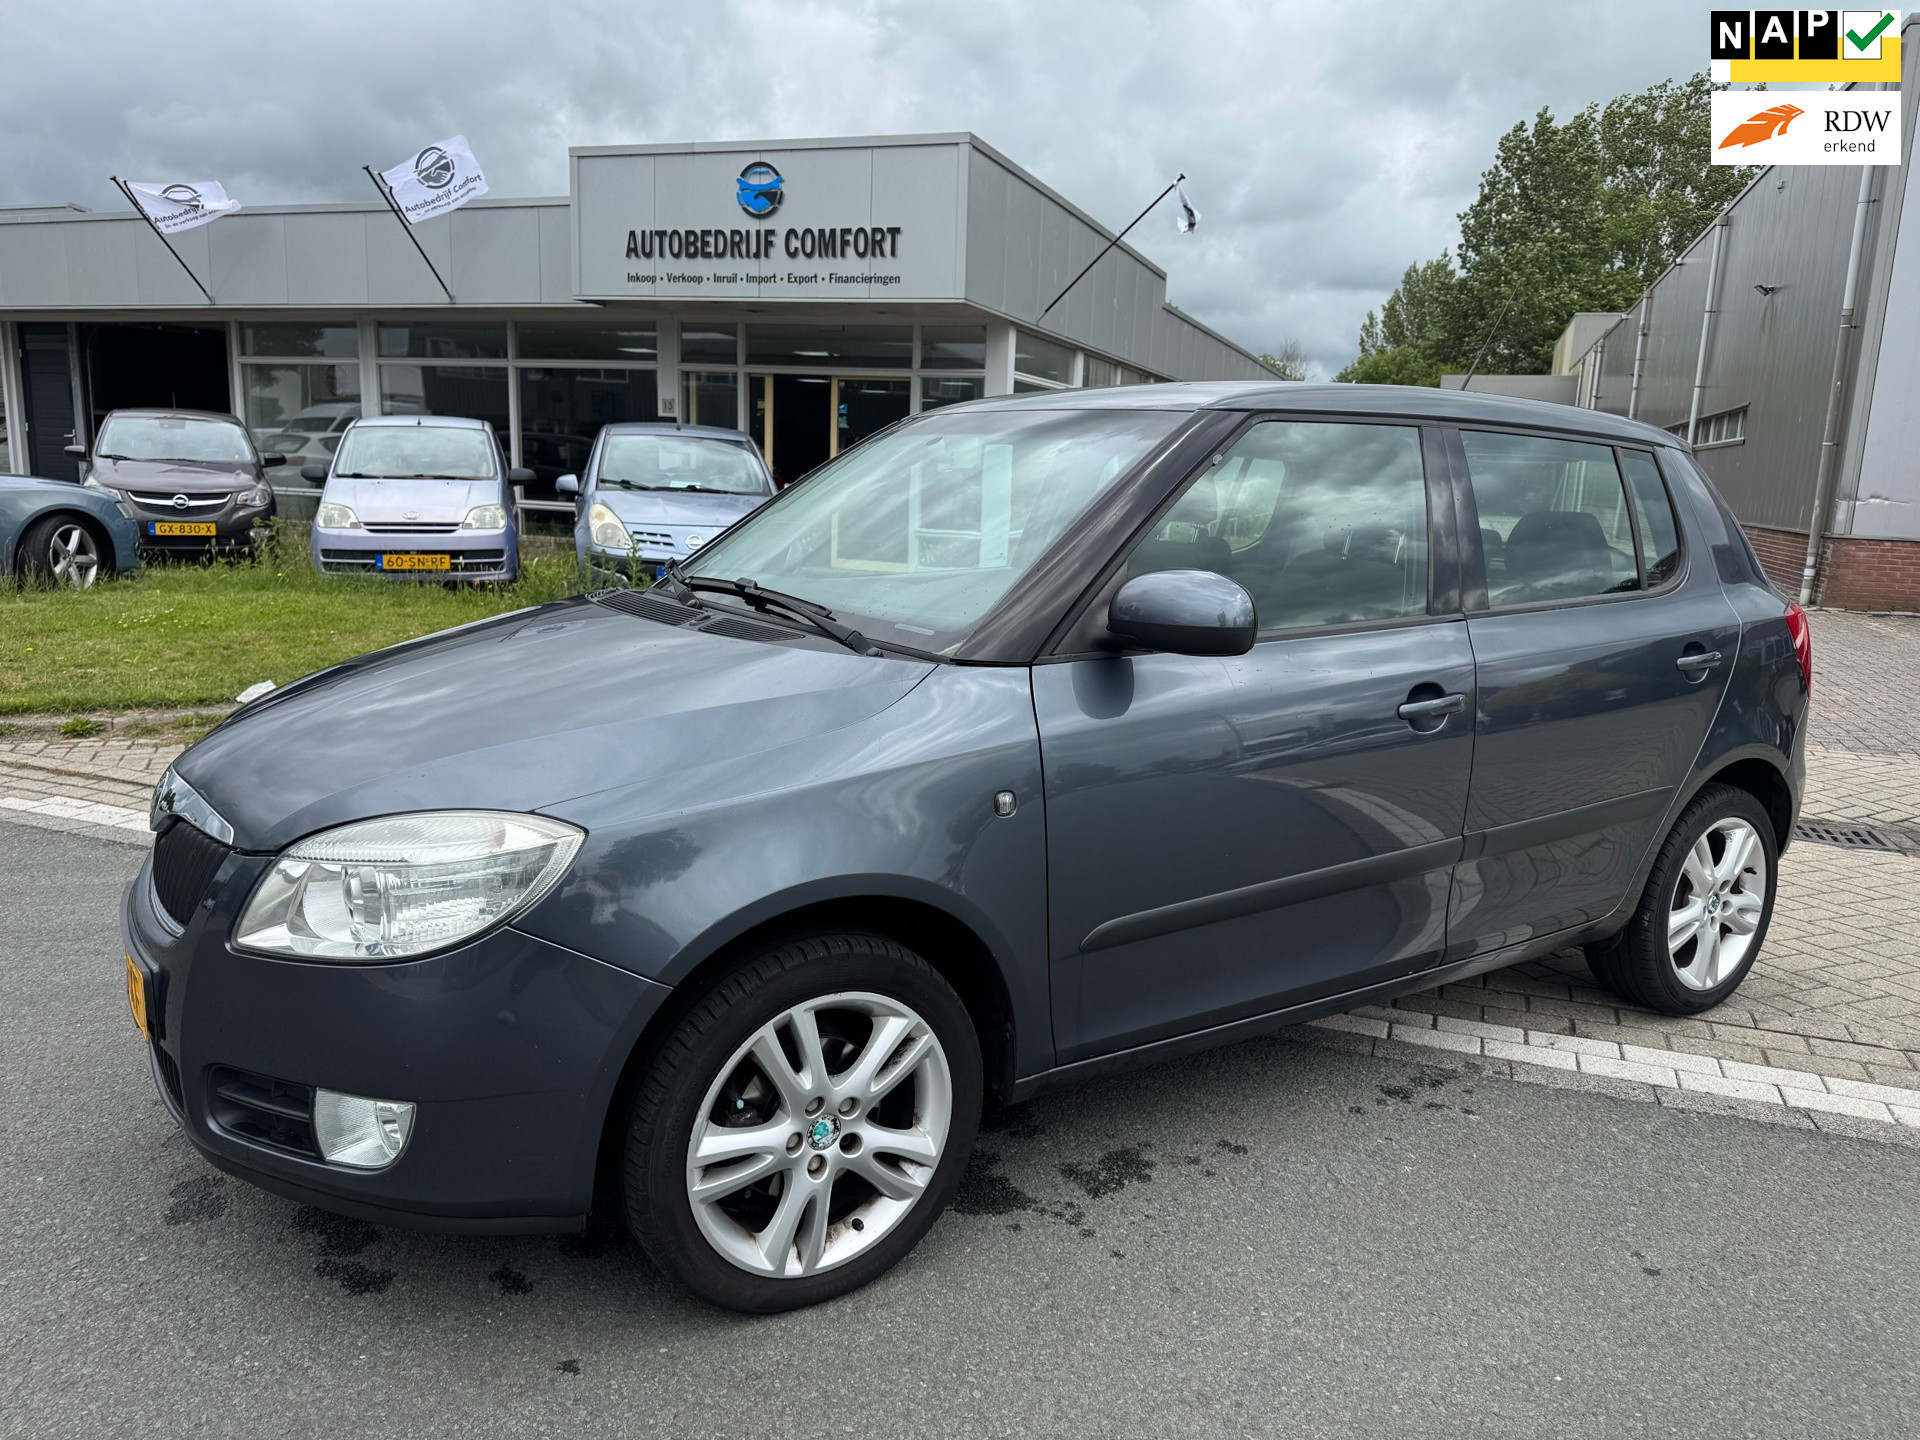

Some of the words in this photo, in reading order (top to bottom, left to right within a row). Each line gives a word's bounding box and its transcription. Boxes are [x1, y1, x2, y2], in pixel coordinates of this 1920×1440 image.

[405, 188, 452, 213] Autobedrijf
[453, 174, 483, 193] Comfort
[625, 229, 776, 259] AUTOBEDRIJF
[784, 227, 902, 259] COMFORT
[627, 272, 657, 284] Inkoop
[666, 272, 703, 285] Verkoop
[713, 272, 738, 284] Inruil
[746, 272, 777, 285] Import
[787, 272, 818, 285] Export
[829, 272, 901, 286] Financieringen
[159, 524, 213, 534] GX-830-X
